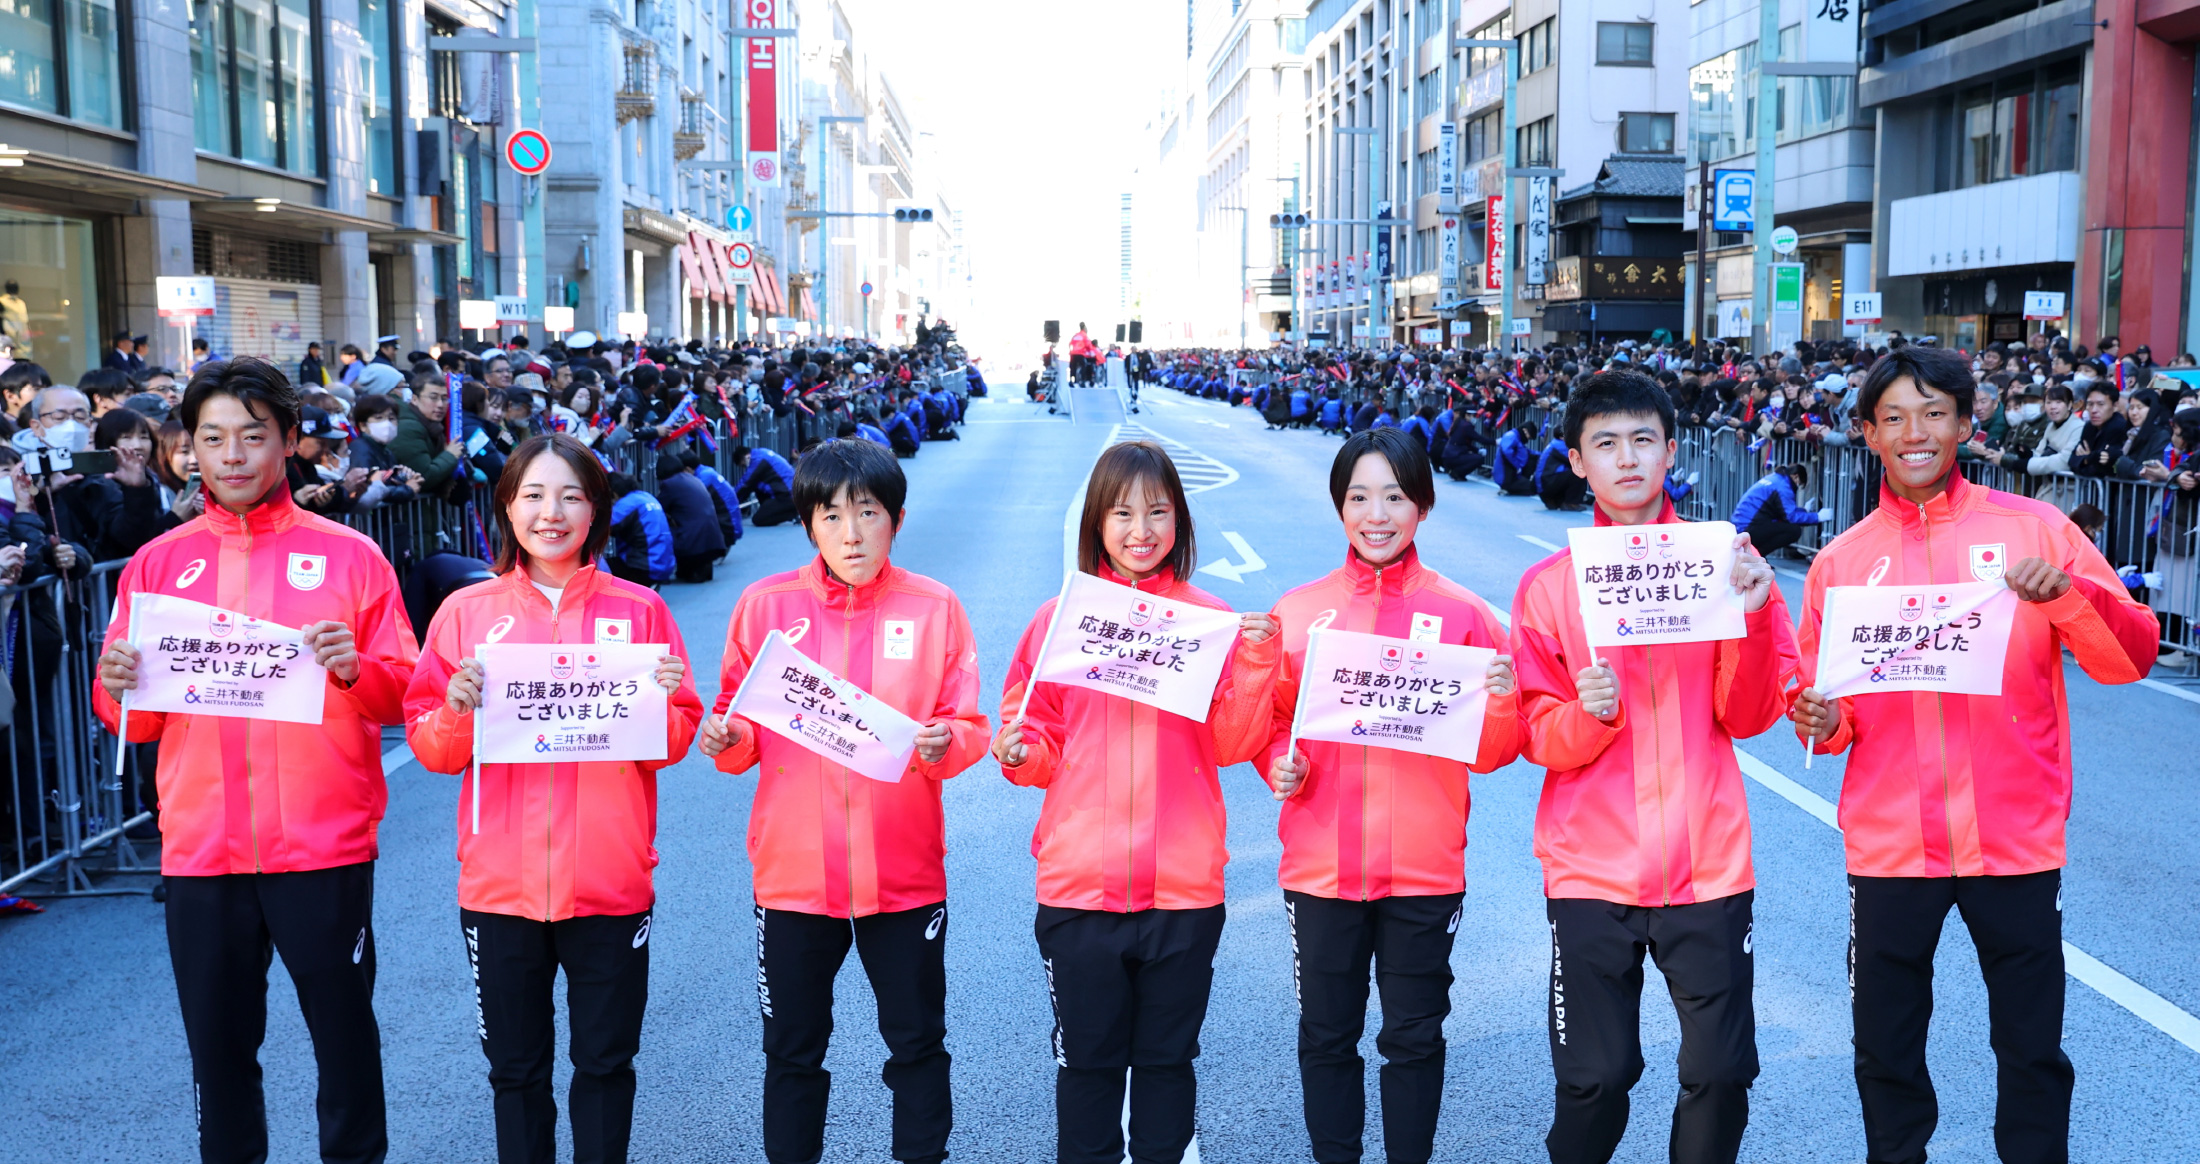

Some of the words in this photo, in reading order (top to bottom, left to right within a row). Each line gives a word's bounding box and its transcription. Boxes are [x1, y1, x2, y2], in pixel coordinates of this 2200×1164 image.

[502, 303, 527, 315] W11
[1854, 301, 1872, 313] E11
[1585, 559, 1715, 584] 応援ありがとう
[1598, 582, 1707, 605] ございました
[1635, 615, 1691, 628] 三井不動産
[1078, 615, 1201, 652] 応援ありがとう
[159, 636, 300, 660] 応援ありがとう
[1080, 639, 1186, 673] ございました
[170, 655, 287, 679] ございました
[1889, 664, 1947, 676] 三井不動産
[506, 680, 638, 700] 応援ありがとう
[1103, 678, 1125, 689] MITSUI
[1126, 683, 1157, 696] FUDOSAN
[1104, 668, 1160, 690] 三井不動産
[1333, 668, 1462, 697] 応援ありがとう
[204, 686, 265, 701] 三井不動産
[230, 700, 264, 708] FUDOSAN
[1340, 689, 1449, 716] ございました
[518, 702, 629, 722] ございました
[553, 734, 610, 744] 三井不動産
[806, 720, 858, 753] 三井不動産
[1371, 722, 1425, 735] 三井不動産
[1393, 734, 1423, 742] FUDOSAN
[803, 731, 824, 745] MITSUI
[824, 741, 854, 759] FUDOSAN
[756, 907, 766, 960] TEAM
[757, 960, 773, 1018] JAPAN
[1554, 980, 1566, 1046] JAPAN
